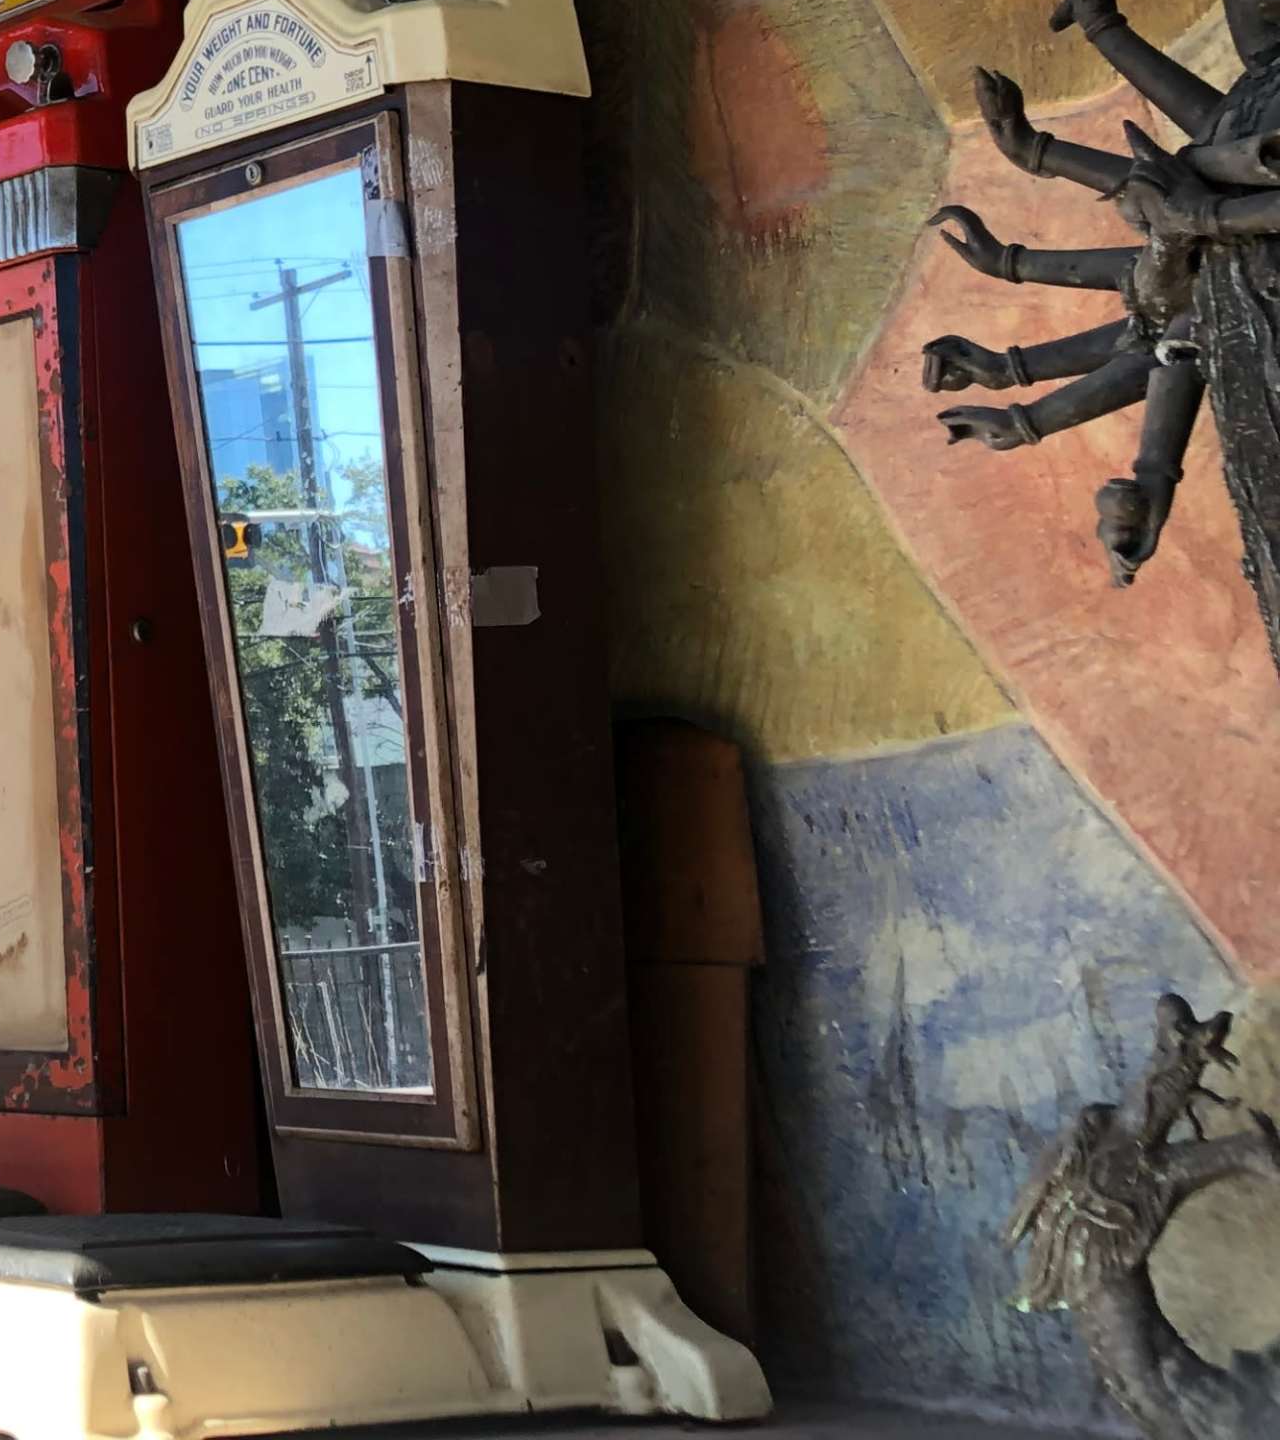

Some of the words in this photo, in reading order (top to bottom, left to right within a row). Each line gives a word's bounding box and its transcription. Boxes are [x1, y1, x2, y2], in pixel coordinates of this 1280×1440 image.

[182, 61, 206, 102] YOUR
[203, 19, 242, 61] WEIGHT
[246, 13, 270, 32] AND
[274, 14, 322, 63] FORTUNE
[208, 71, 224, 96] HOW
[222, 49, 242, 74] MUCH
[242, 46, 255, 62] DO
[204, 100, 234, 120] GUARD
[238, 90, 263, 109] YOUR
[267, 77, 302, 100] HEALTH
